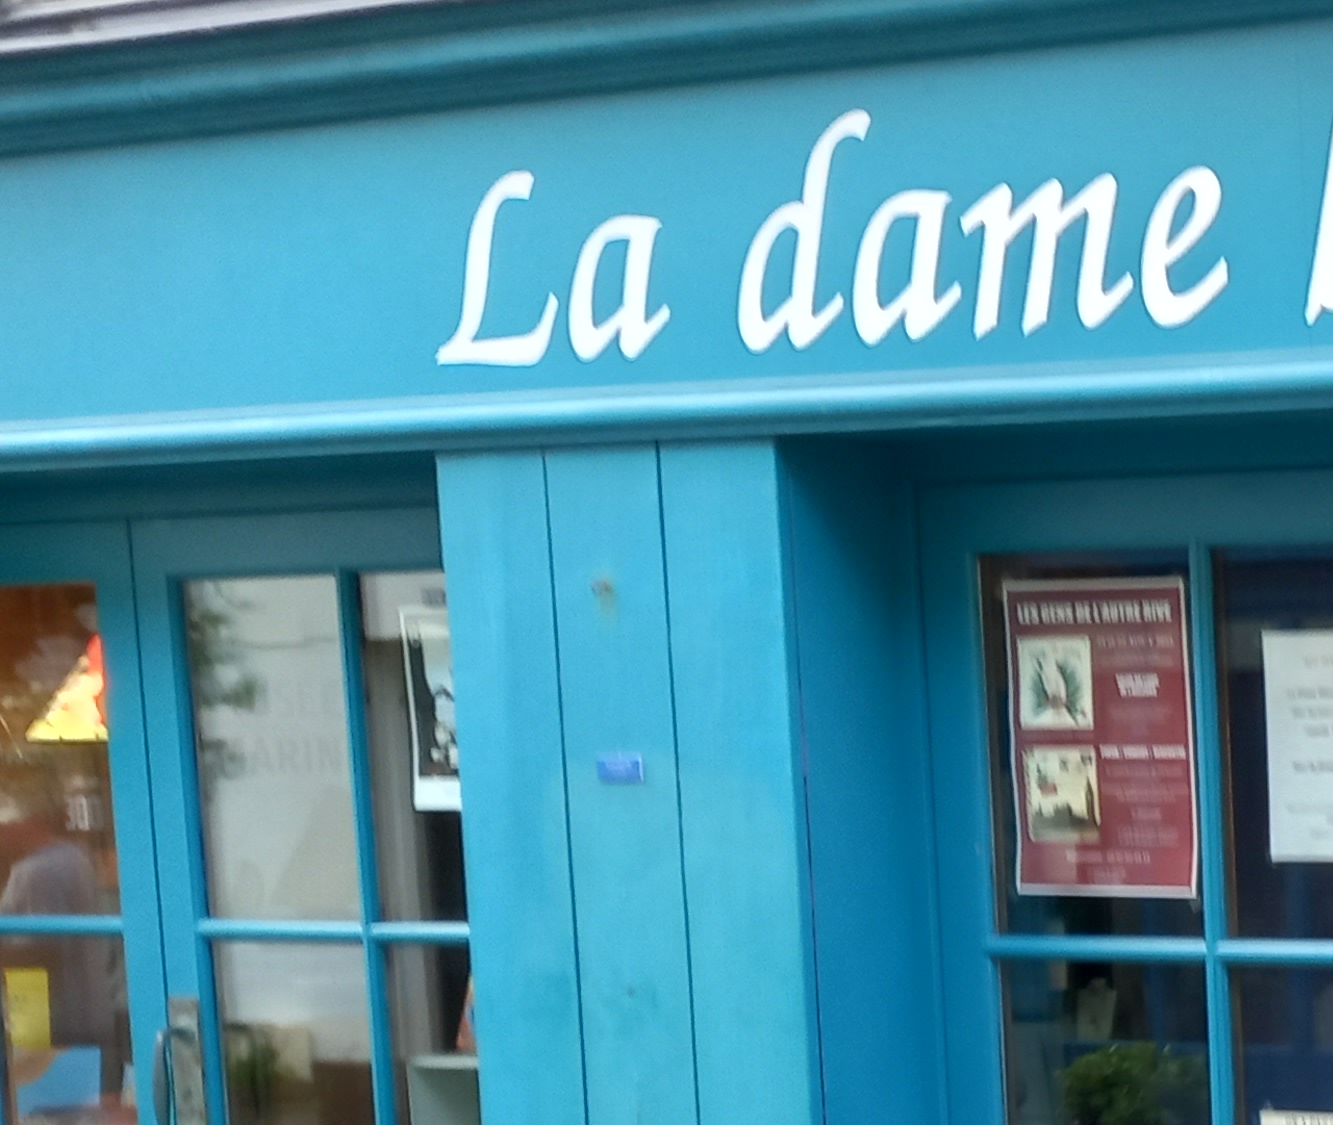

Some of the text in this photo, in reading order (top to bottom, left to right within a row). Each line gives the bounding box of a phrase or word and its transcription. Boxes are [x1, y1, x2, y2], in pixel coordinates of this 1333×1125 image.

[436, 169, 671, 367] La
[736, 108, 1229, 354] dame
[1016, 602, 1039, 625] LES
[1075, 601, 1092, 624] DE
[1141, 599, 1172, 623] RIVE
